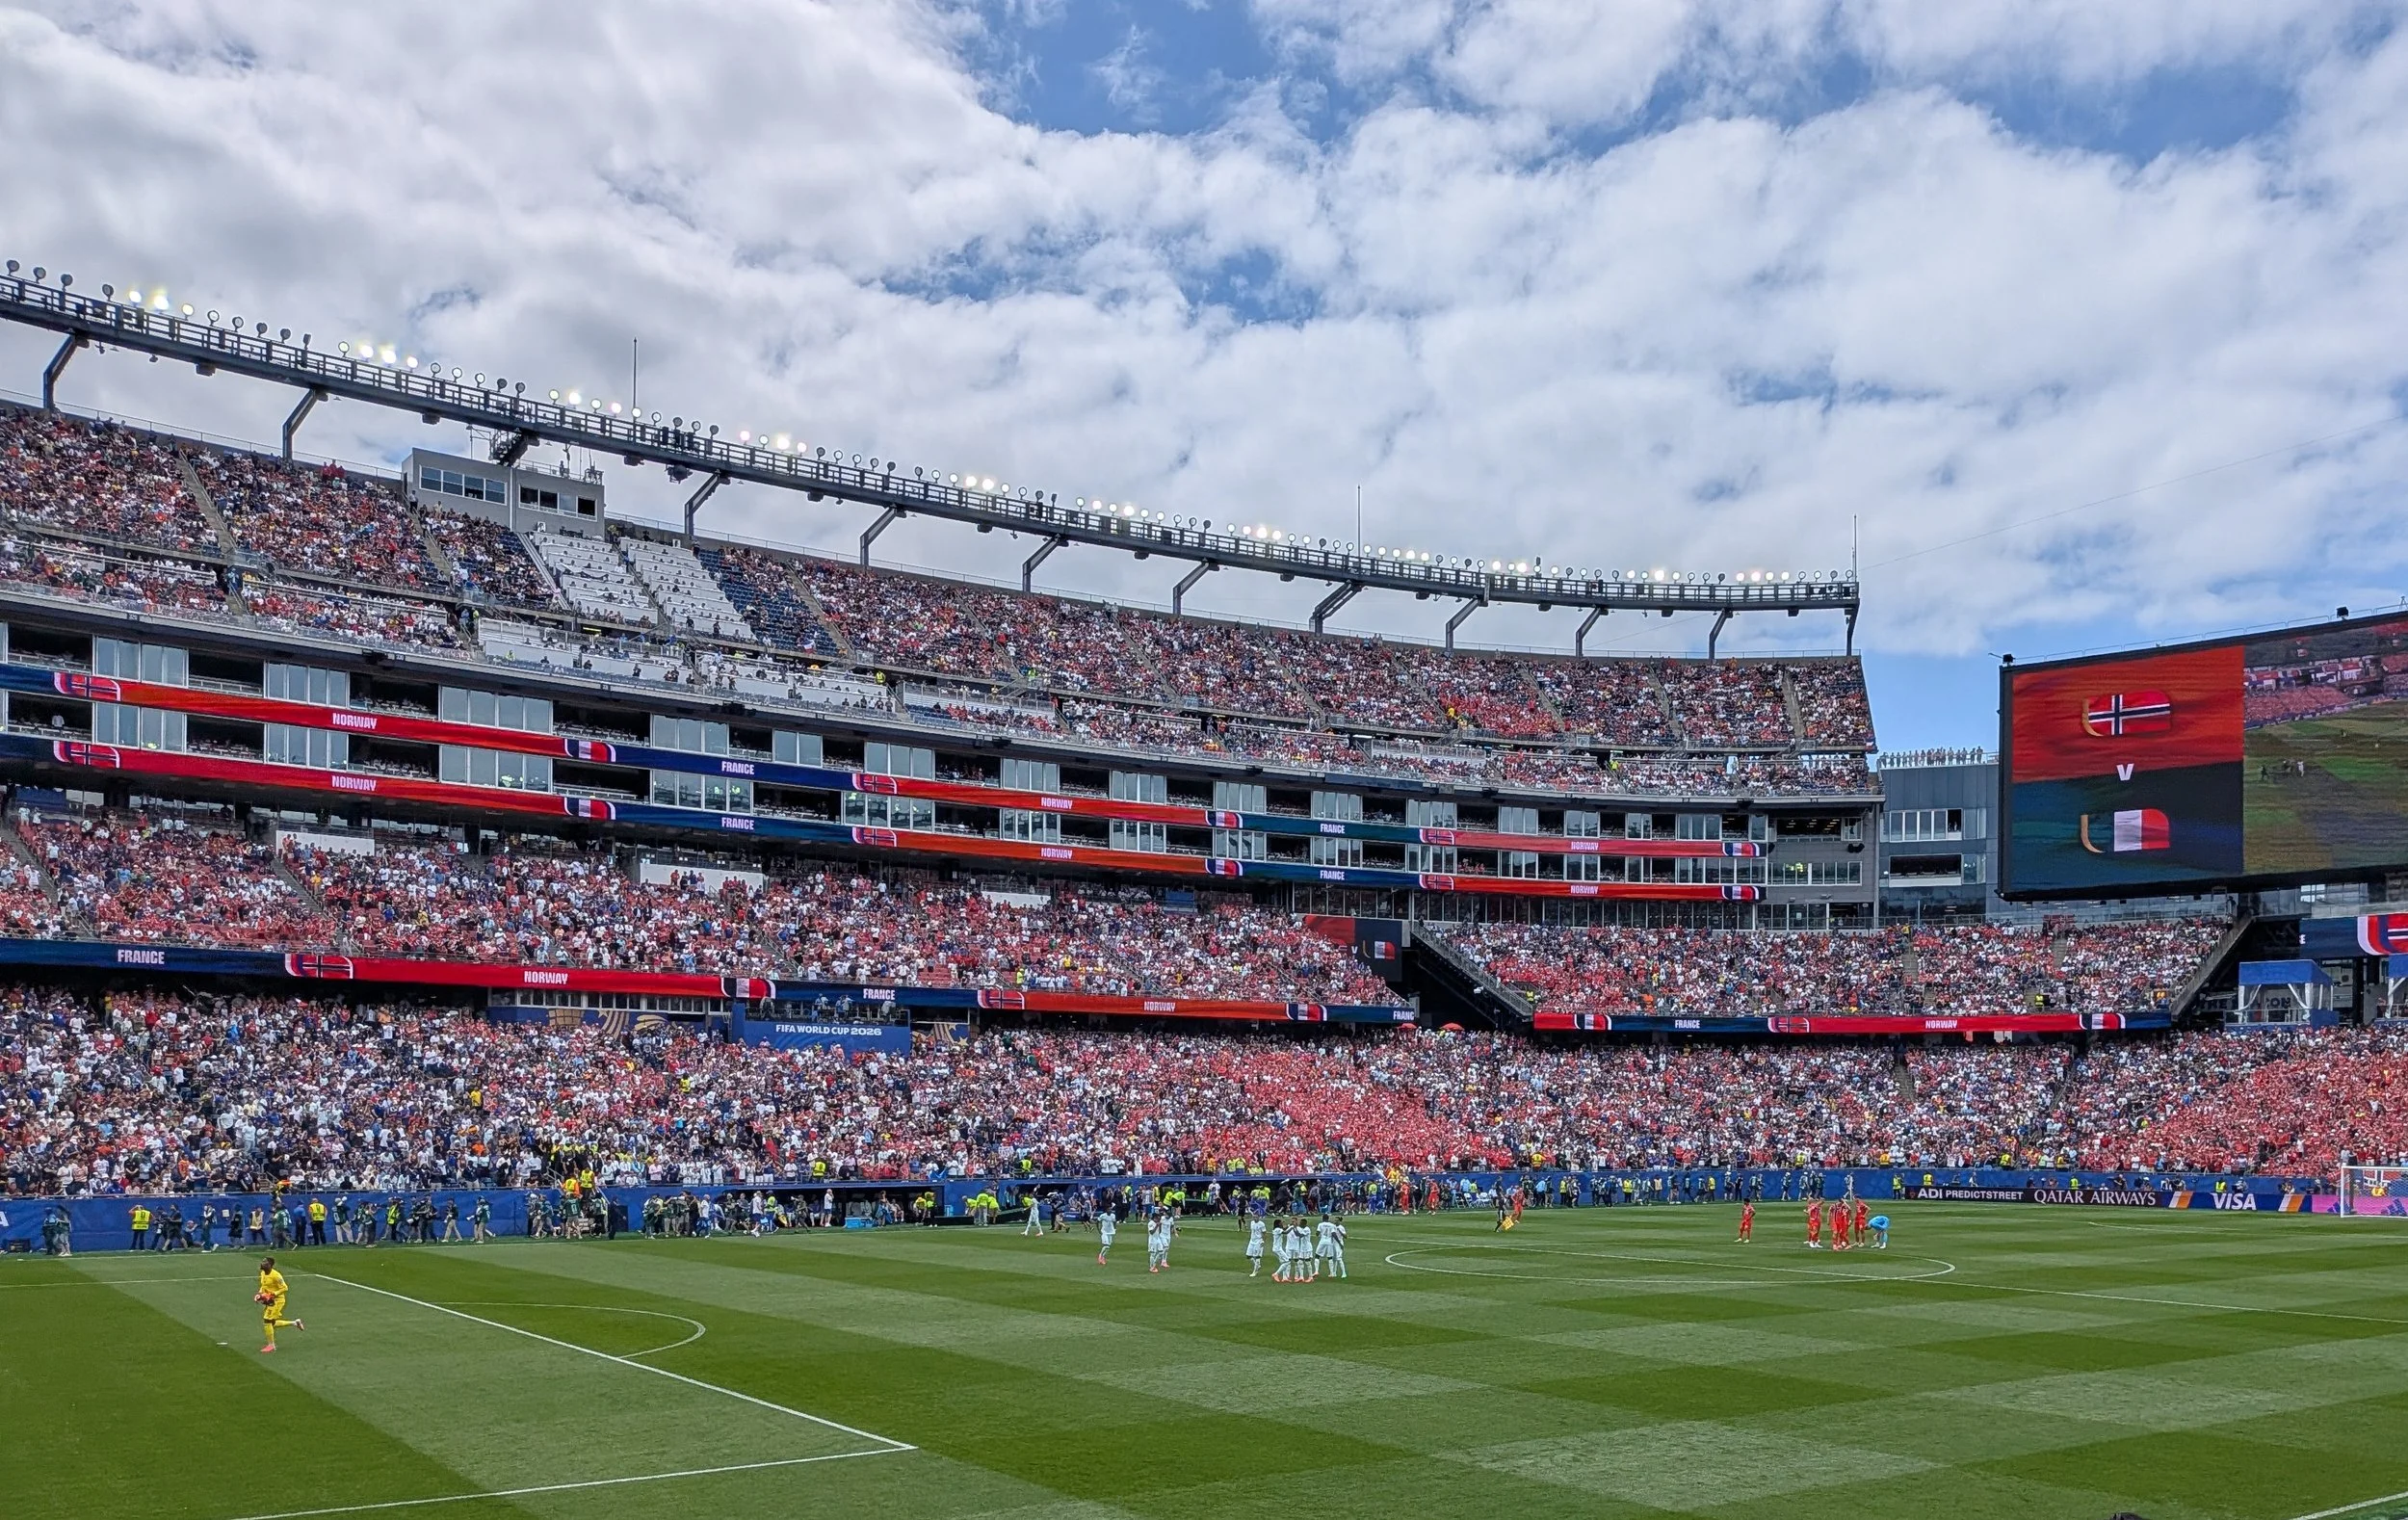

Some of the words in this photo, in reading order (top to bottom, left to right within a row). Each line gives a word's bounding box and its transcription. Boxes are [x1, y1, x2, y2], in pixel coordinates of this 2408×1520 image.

[332, 713, 378, 729] NORWAY
[721, 761, 754, 774] FRANCE
[331, 774, 377, 792] NORWAY
[1041, 797, 1073, 810] NORWAY
[721, 817, 754, 830] FRANCE
[1320, 823, 1346, 834] FRANCE
[1570, 841, 1599, 852] NORWAY
[1041, 847, 1073, 860] NORWAY
[1320, 870, 1346, 881] FRANCE
[1570, 884, 1599, 895] NORWAY
[118, 949, 165, 964] FRANCE
[524, 970, 568, 984] NORWAY
[863, 988, 896, 1001] FRANCE
[1143, 1001, 1176, 1012] NORWAY
[775, 1024, 796, 1033] FIFA
[797, 1025, 830, 1035] WORLD
[851, 1027, 882, 1035] 2026
[1674, 1018, 1700, 1030] FRANCE
[1925, 1020, 1957, 1030] NORWAY
[1918, 1188, 1943, 1199] ADI
[1946, 1190, 2023, 1200] PREDICTSTREET
[2034, 1189, 2083, 1204] QATAR
[2090, 1190, 2156, 1205] AIRWAYS
[2212, 1193, 2257, 1211] VISA
